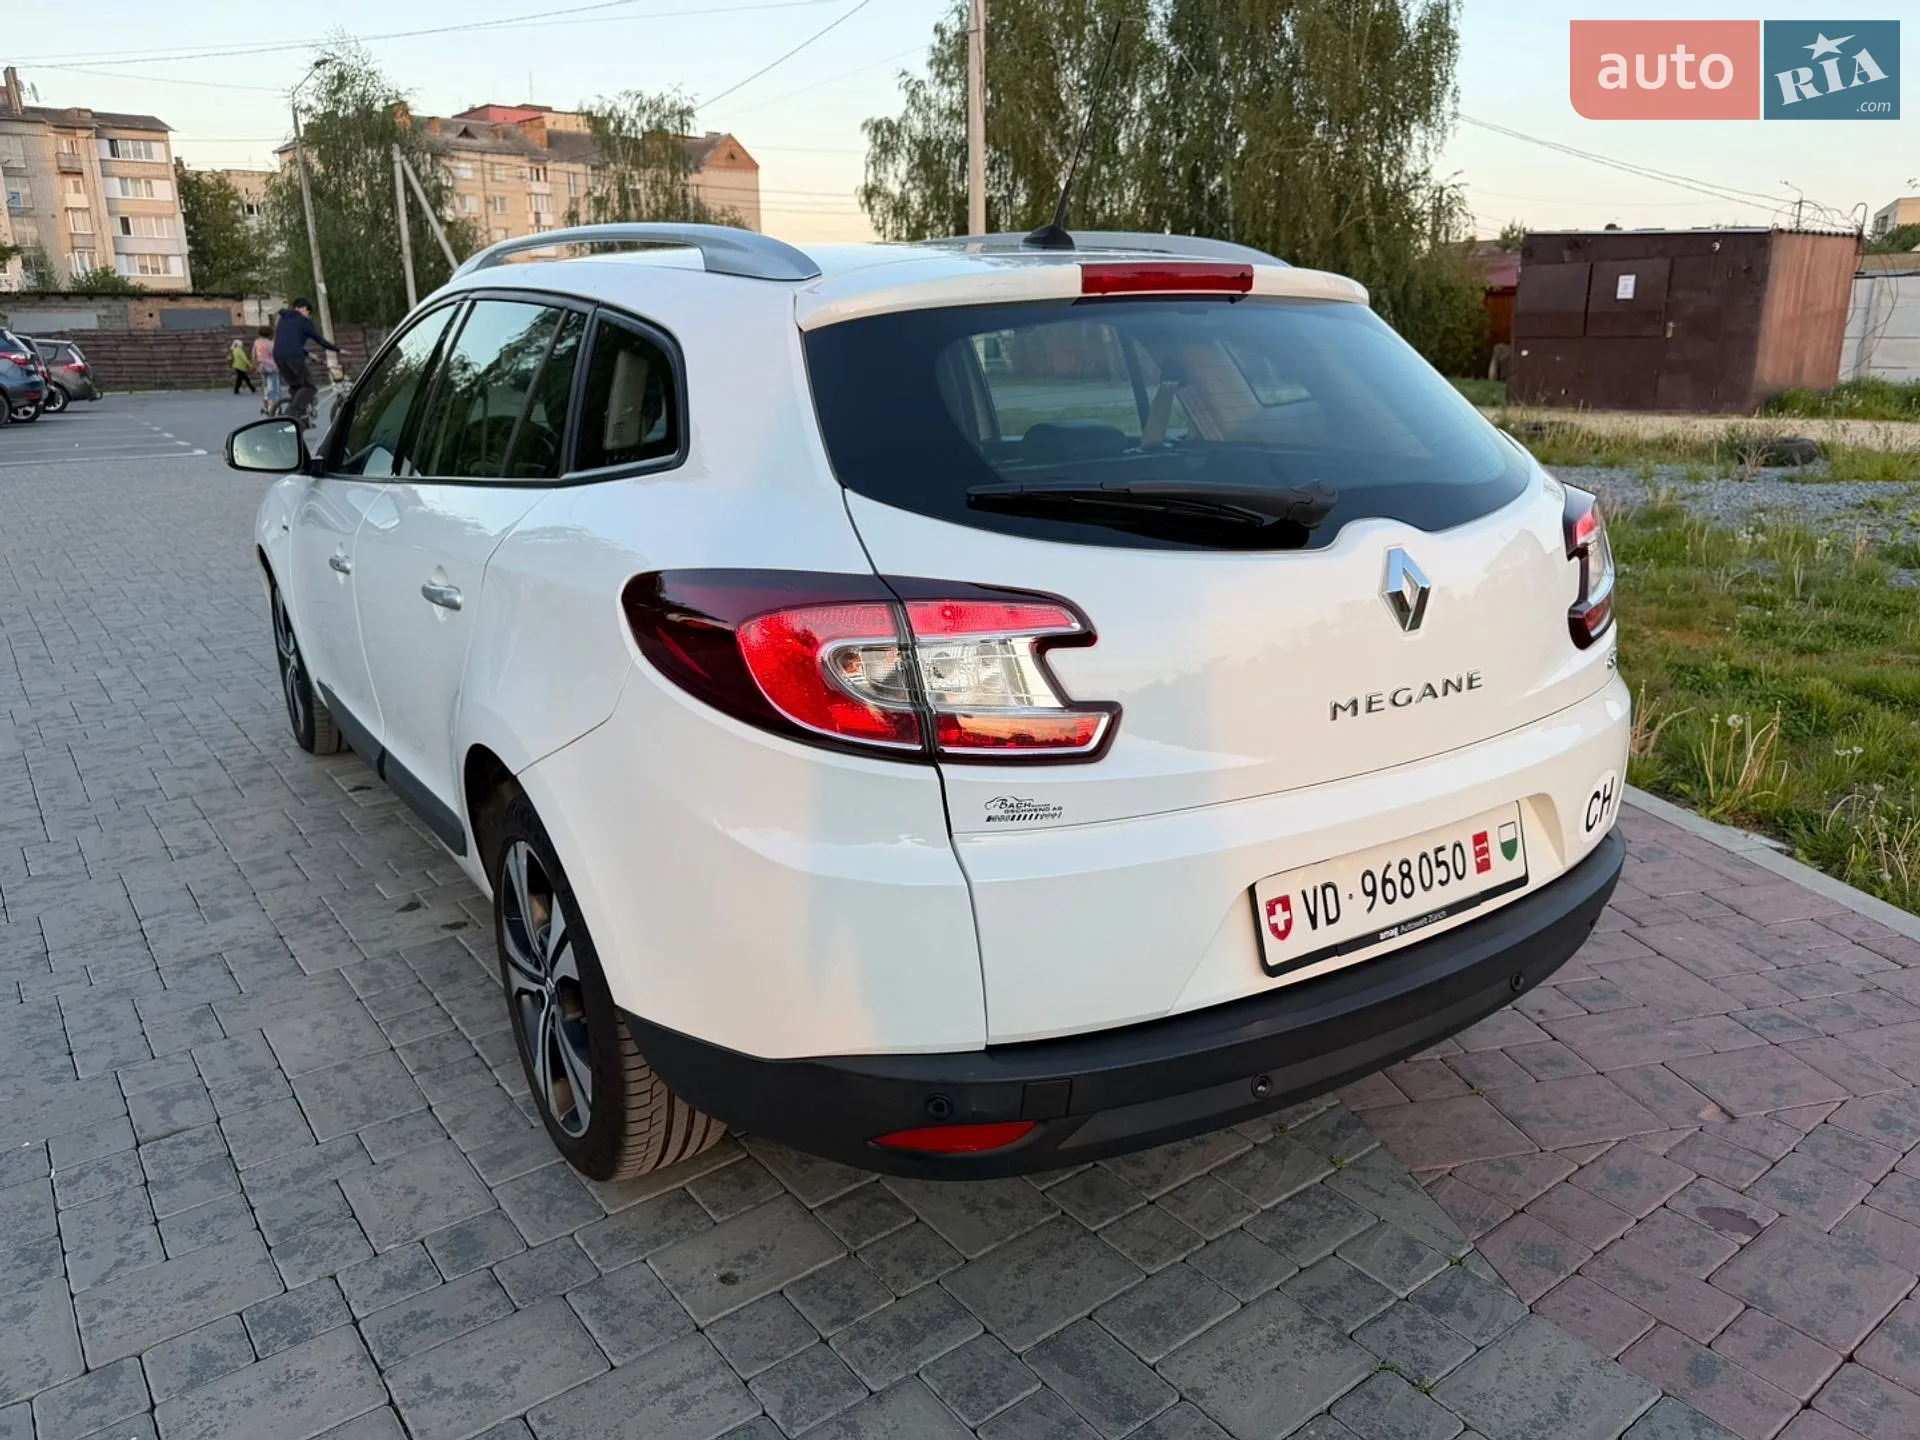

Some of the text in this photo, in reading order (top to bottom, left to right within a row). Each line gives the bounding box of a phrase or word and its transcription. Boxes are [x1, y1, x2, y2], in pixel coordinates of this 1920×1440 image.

[1329, 670, 1483, 721] MEGANE
[1585, 775, 1615, 833] CH
[1301, 840, 1467, 931] VD 968050
